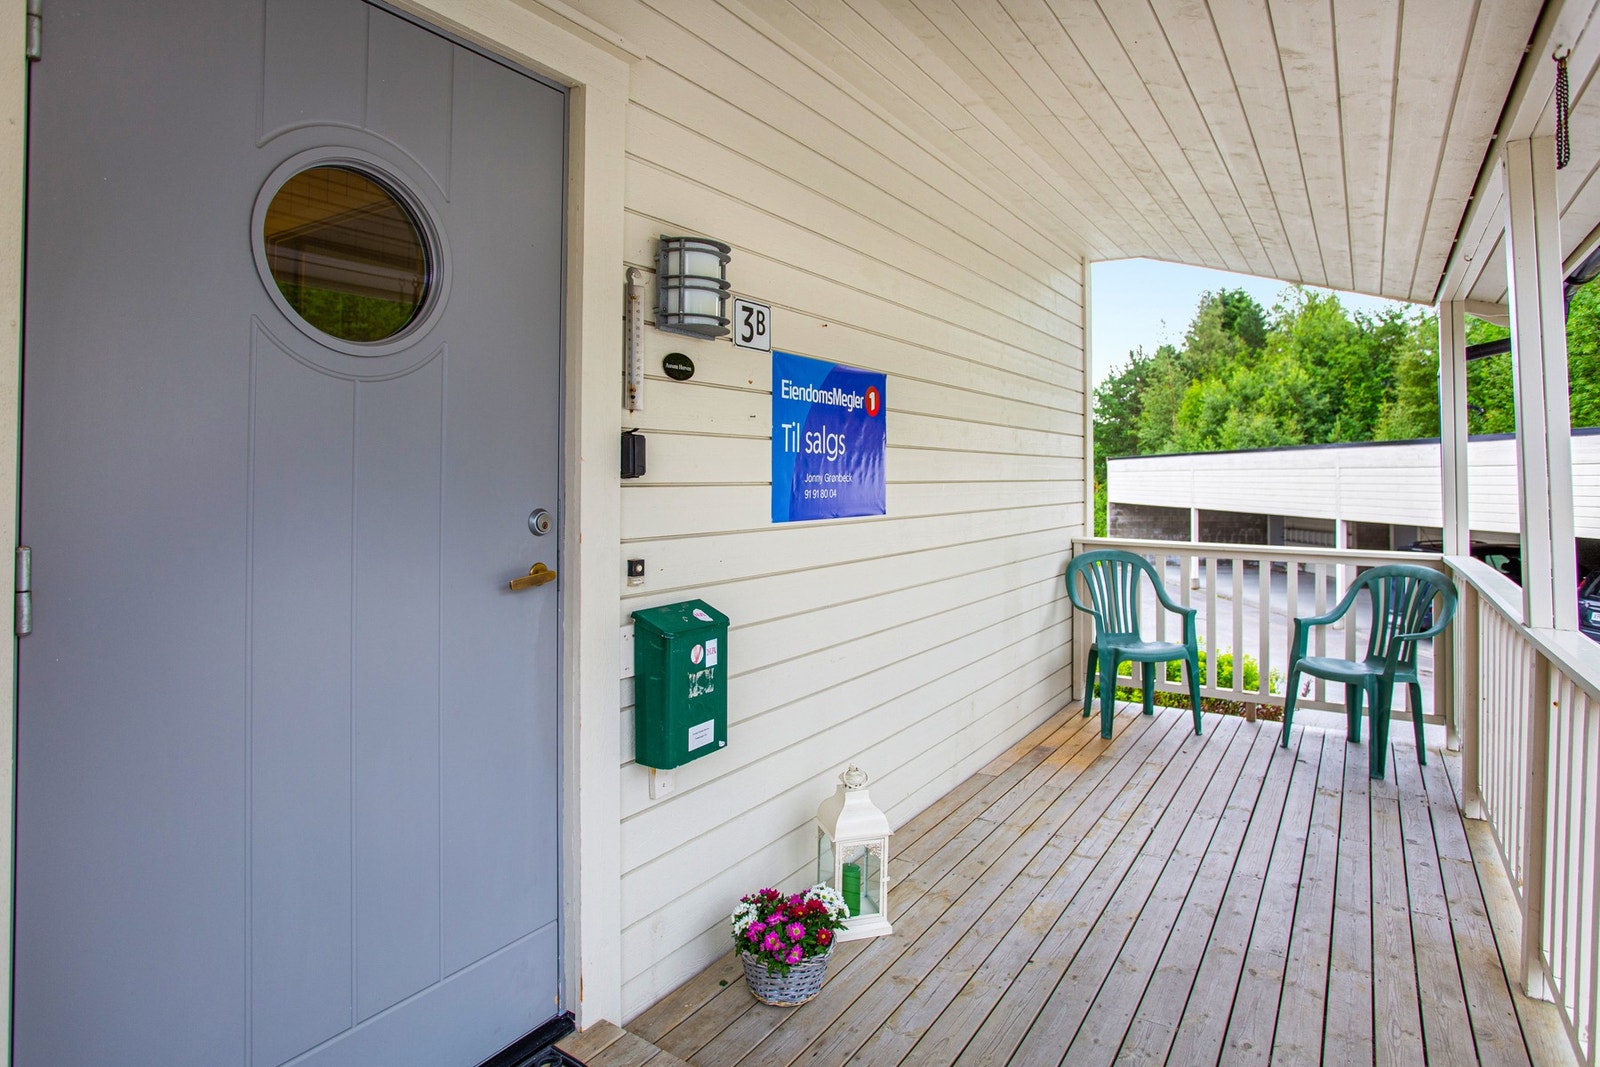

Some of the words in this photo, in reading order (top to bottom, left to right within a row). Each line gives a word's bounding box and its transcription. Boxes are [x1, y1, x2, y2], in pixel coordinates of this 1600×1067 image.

[741, 305, 766, 343] 3B
[781, 379, 864, 412] EiendomsMegler
[868, 391, 876, 411] 1
[781, 421, 800, 453] Til
[805, 425, 846, 461] salgs
[804, 472, 823, 485] Jonny
[804, 489, 811, 499] 91
[812, 489, 819, 499] 91
[820, 488, 828, 499] 80
[829, 488, 837, 498] 04
